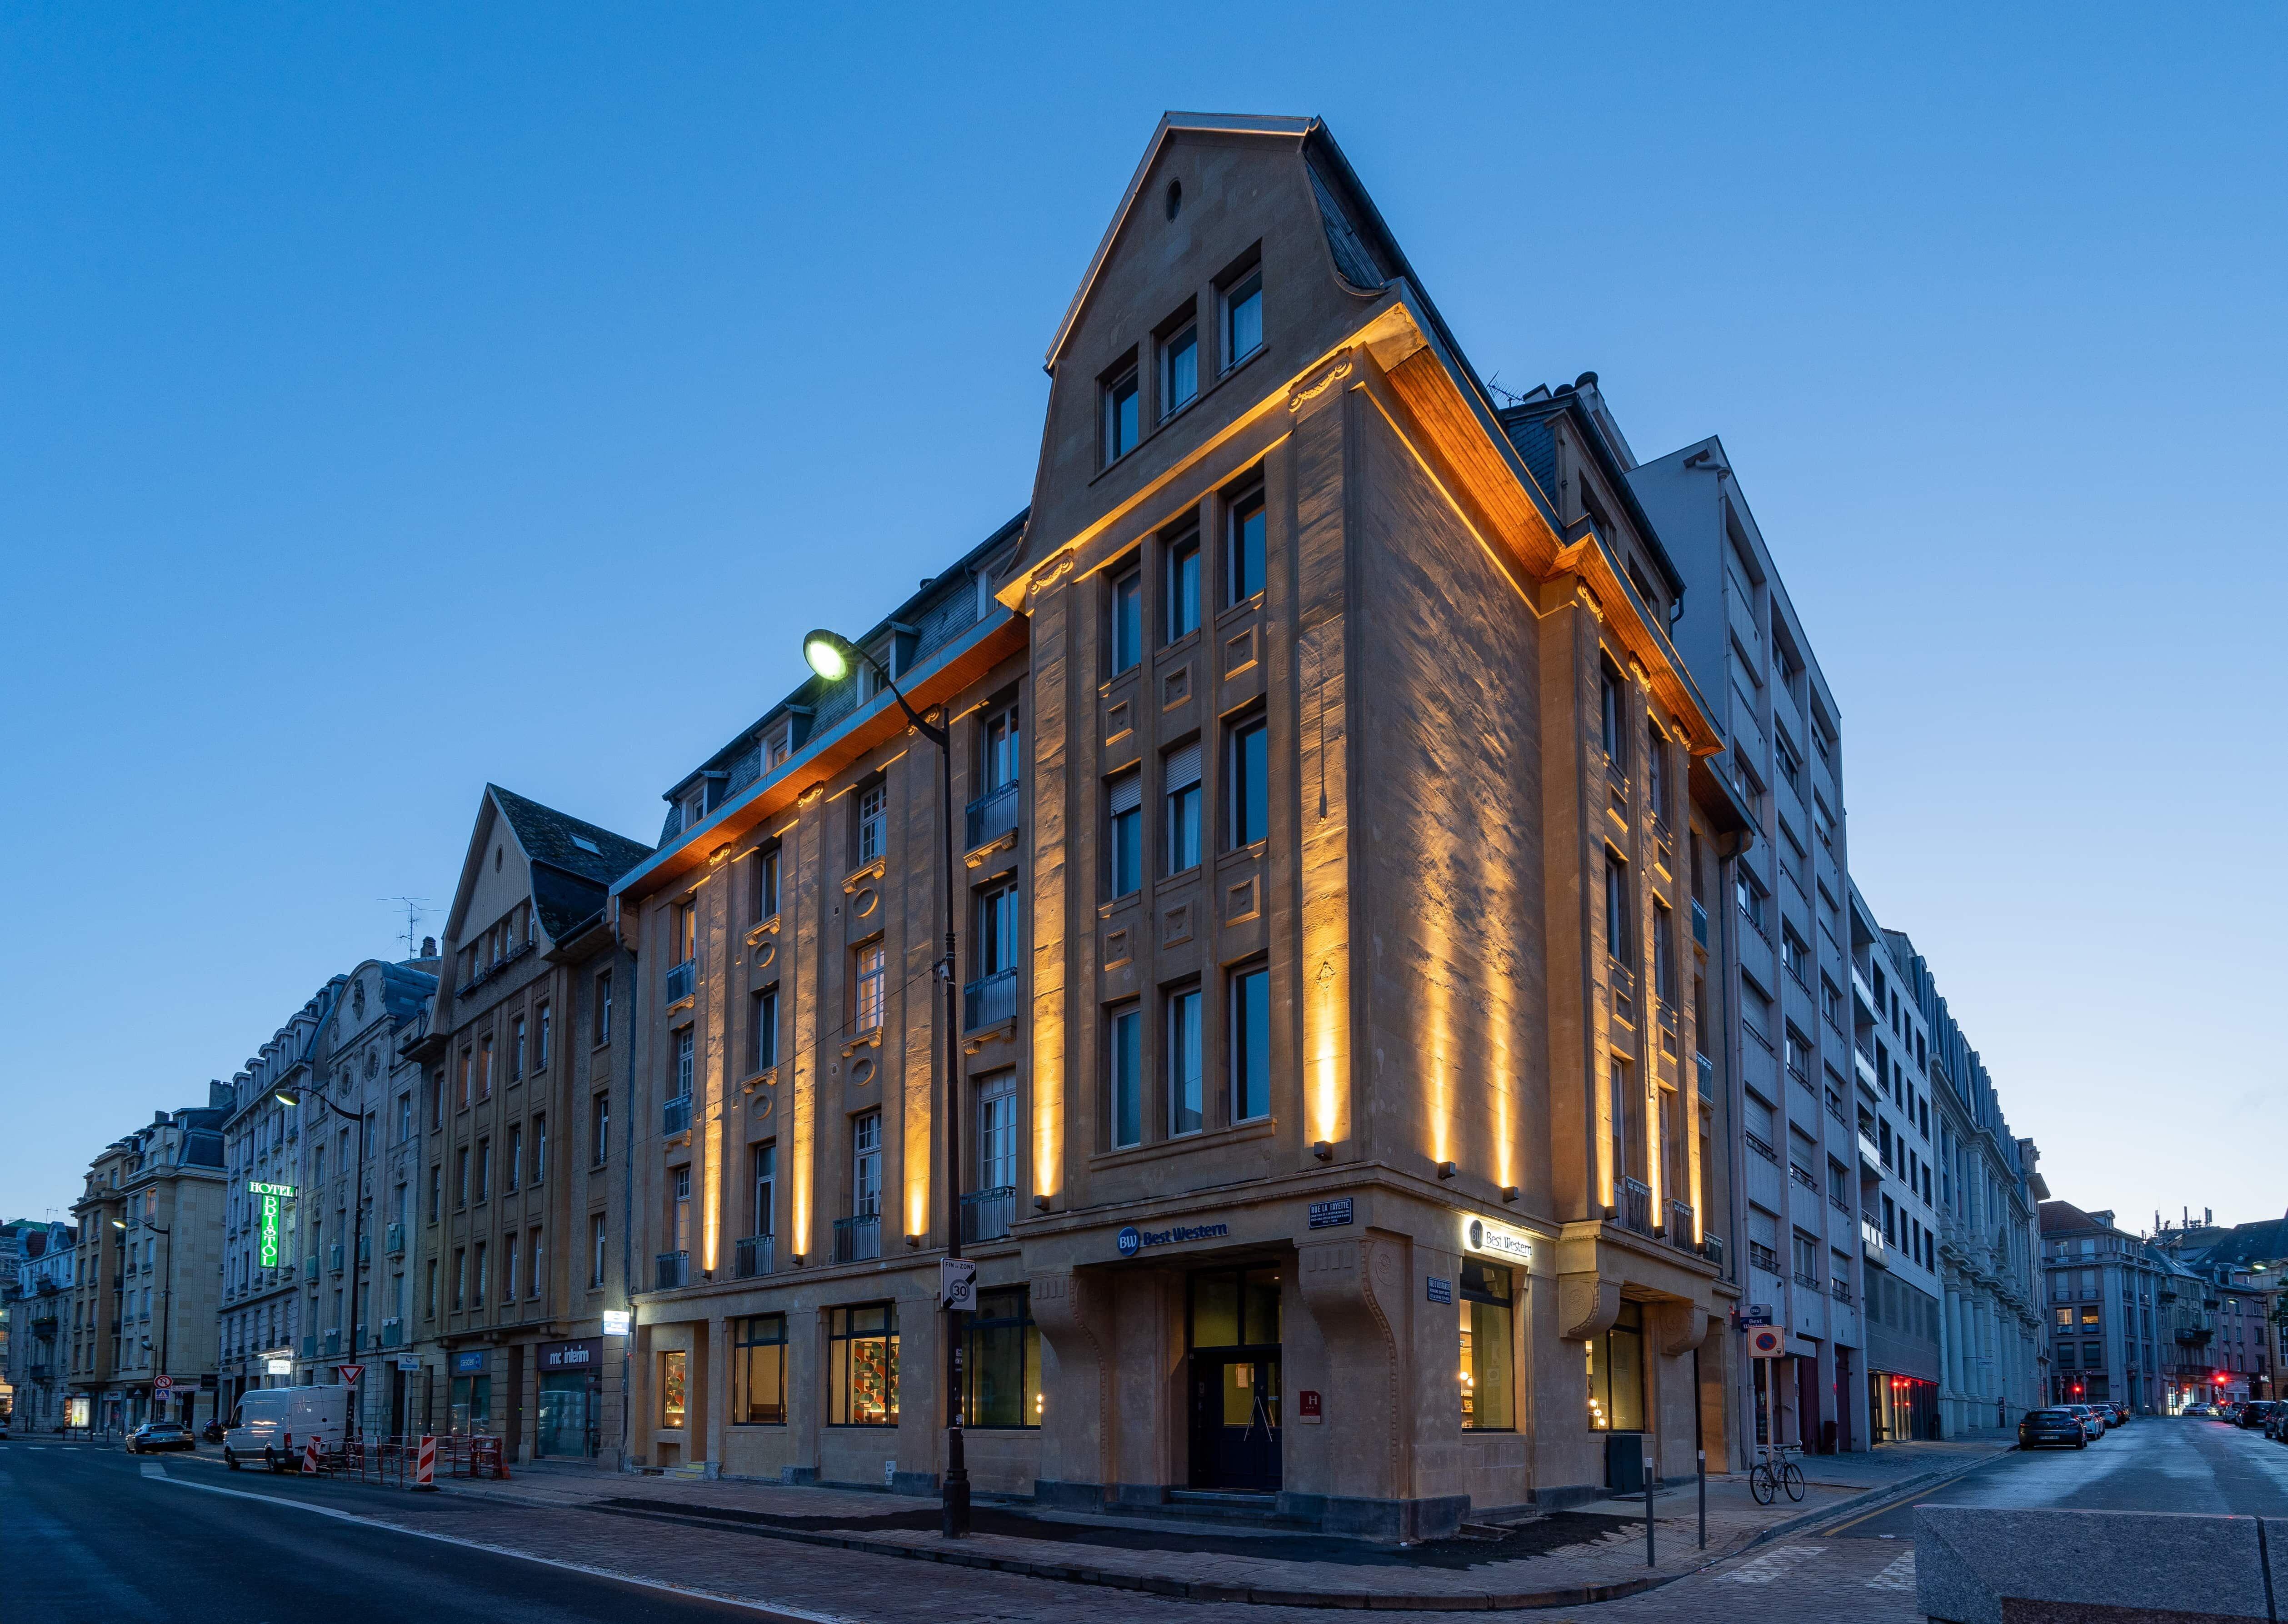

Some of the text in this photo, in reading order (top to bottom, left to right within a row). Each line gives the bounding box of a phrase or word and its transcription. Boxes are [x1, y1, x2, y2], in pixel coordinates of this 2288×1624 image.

[250, 1181, 293, 1197] HOTEL
[1311, 1205, 1321, 1214] RUE
[1330, 1201, 1349, 1211] FAYETTE
[262, 1196, 277, 1267] BRISTOL
[1119, 1223, 1228, 1249] BW Best Western
[1487, 1231, 1502, 1247] Best
[1504, 1236, 1532, 1255] Western
[954, 1285, 967, 1297] 30
[460, 1357, 475, 1367] casden
[550, 1345, 589, 1365] mc interim
[1309, 1395, 1317, 1405] H
